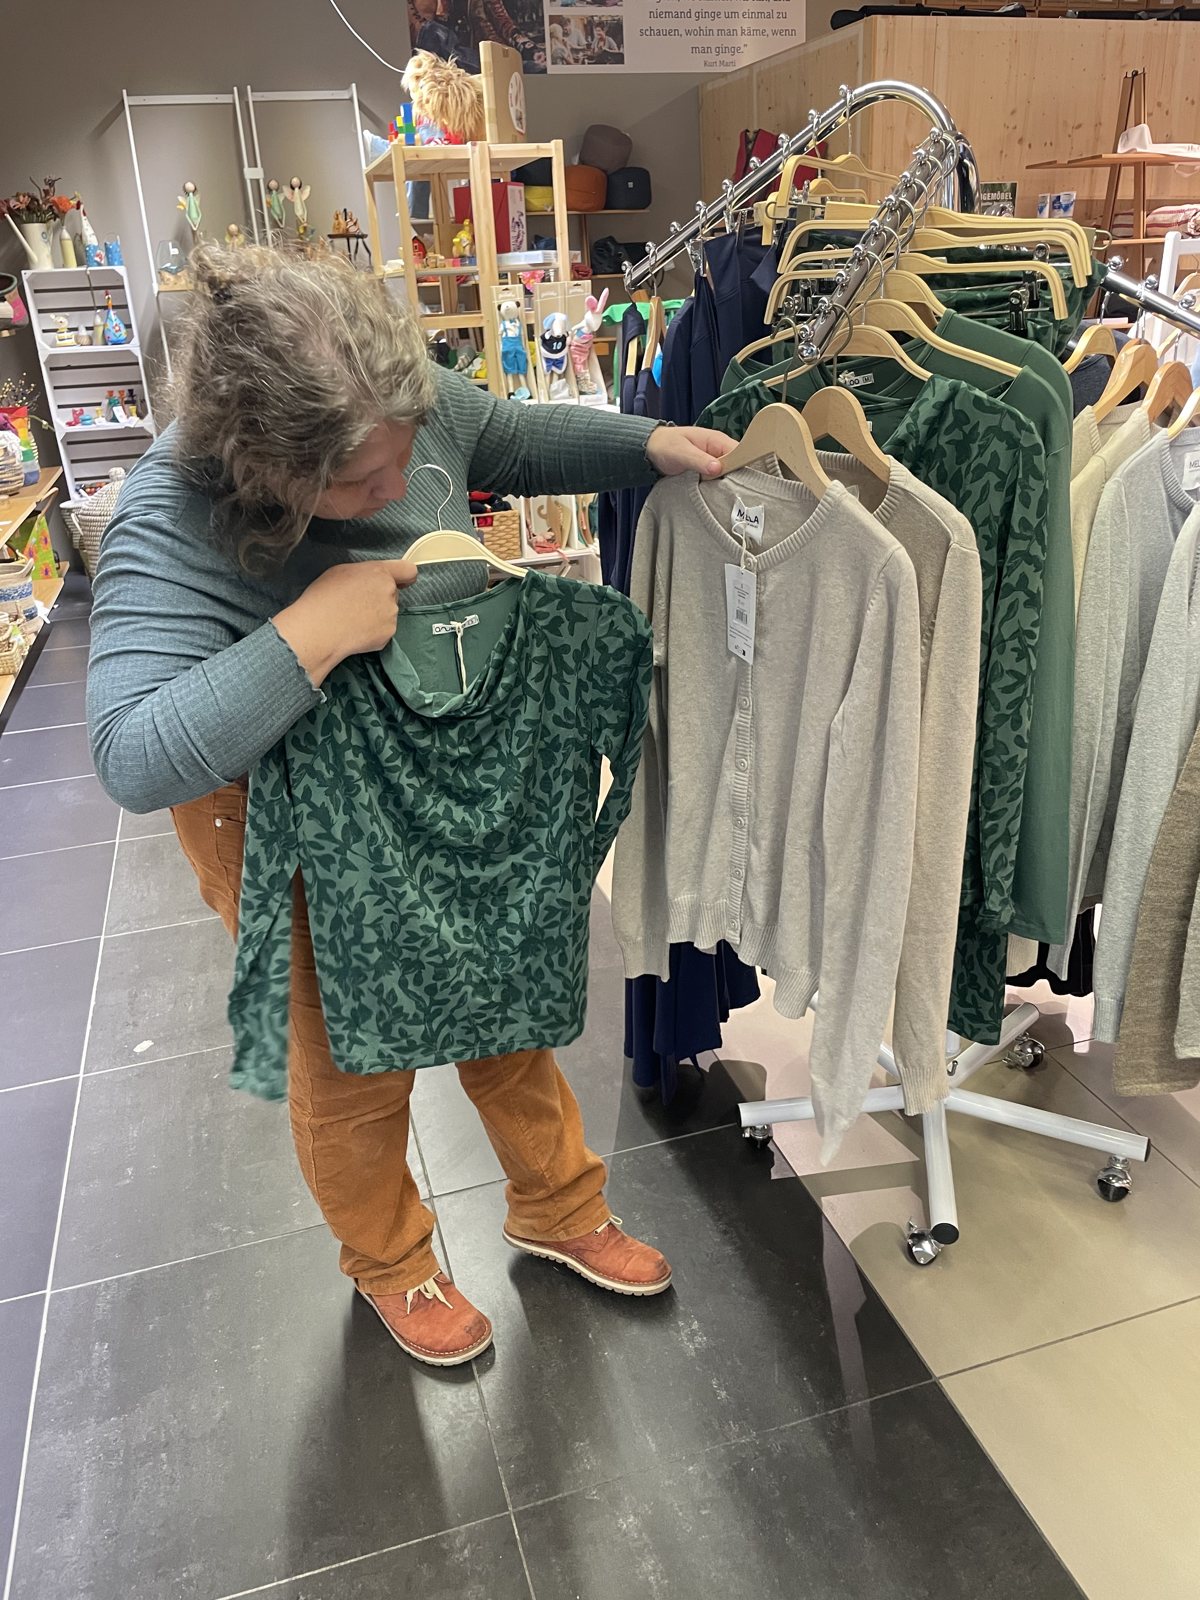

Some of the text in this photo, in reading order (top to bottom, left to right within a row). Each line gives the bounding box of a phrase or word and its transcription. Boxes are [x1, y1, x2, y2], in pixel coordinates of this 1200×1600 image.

[649, 8, 787, 21] niemand ginge um einmal zu
[639, 26, 797, 38] schauen, wohin man käme, wenn
[690, 45, 713, 54] man
[703, 60, 718, 68] Kurt
[552, 341, 562, 350] 10
